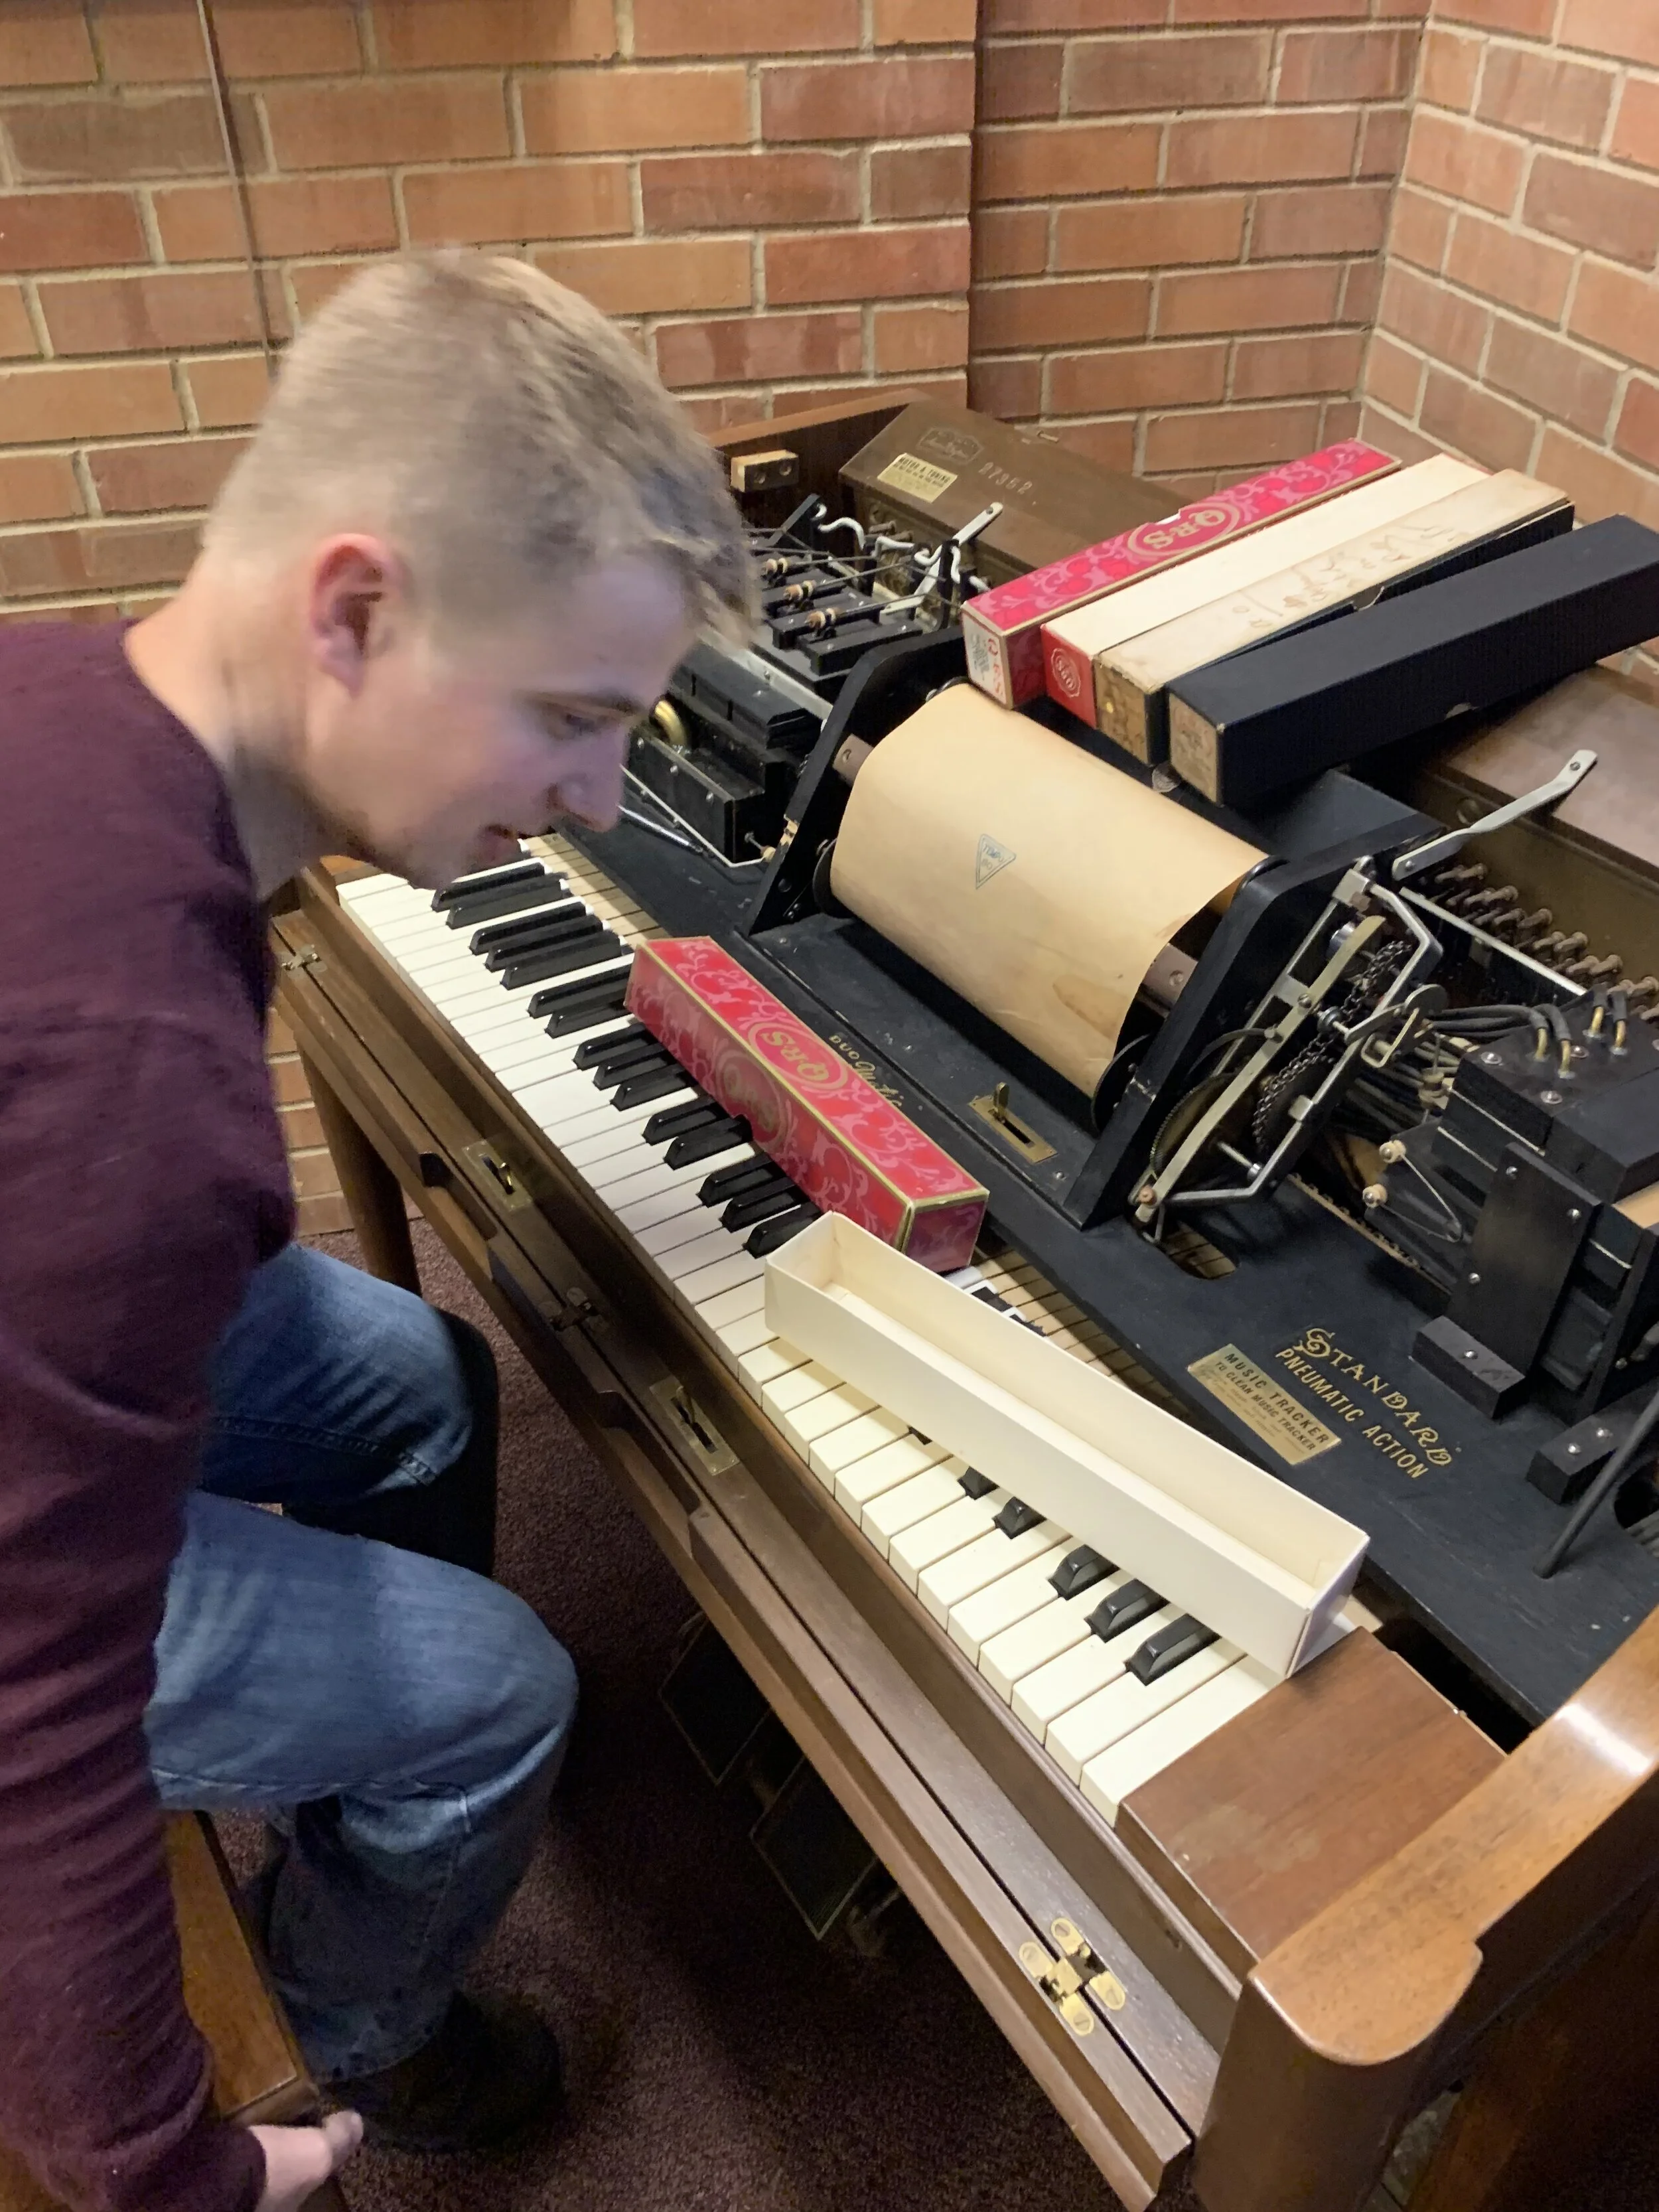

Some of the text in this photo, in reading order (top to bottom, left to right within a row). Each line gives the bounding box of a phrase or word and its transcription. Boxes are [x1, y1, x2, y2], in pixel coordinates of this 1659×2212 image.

[1214, 1361, 1317, 1452] TO CLEAN MUSIC TRACKER
[1224, 1353, 1267, 1389] MUSIC
[1269, 1392, 1330, 1445] TRACKER
[1275, 1348, 1364, 1422] PNEUMATIC
[1362, 1425, 1429, 1479] ACTION
[1293, 1328, 1452, 1465] STANDARD
